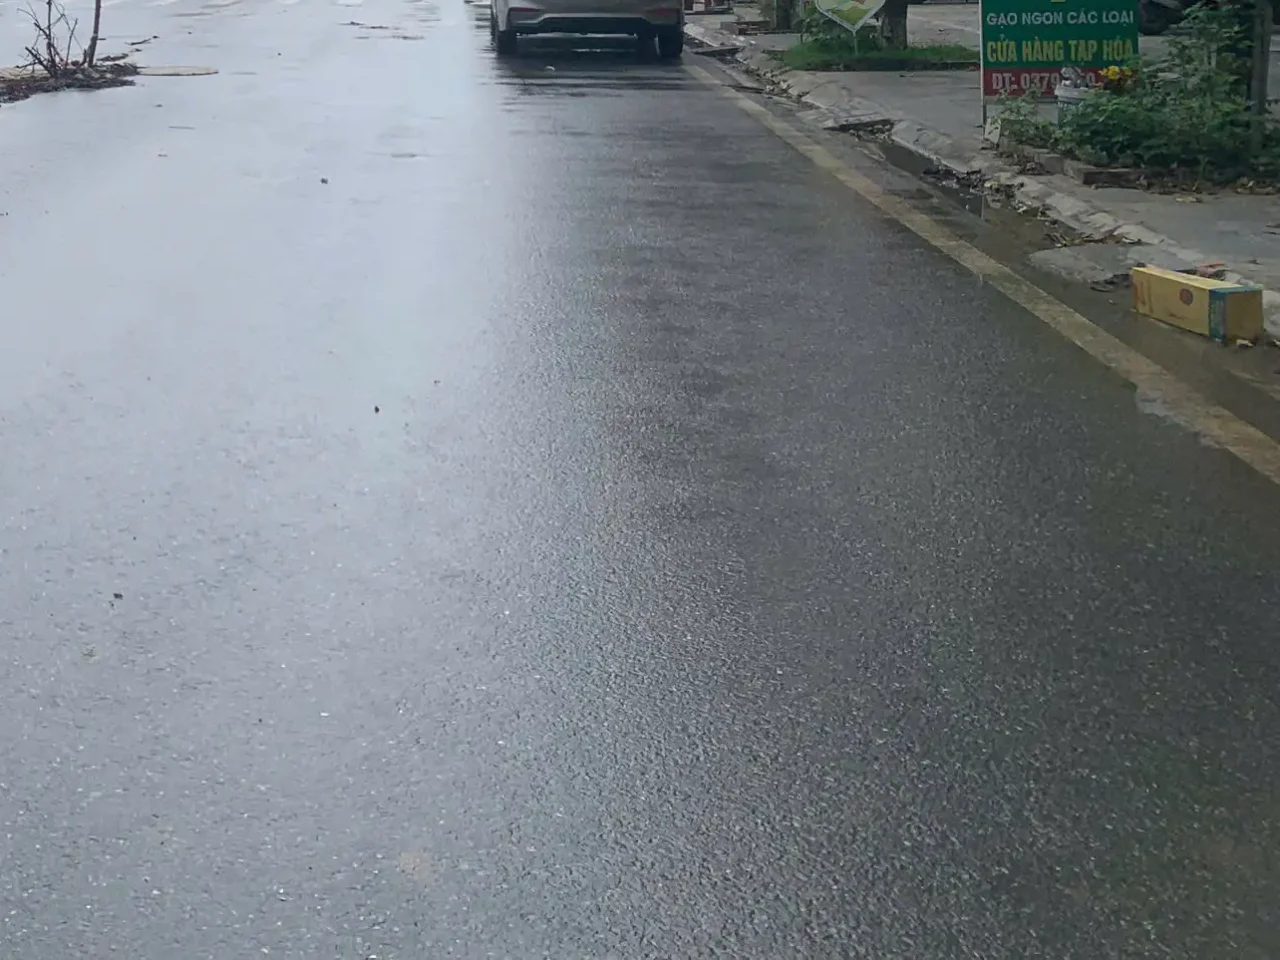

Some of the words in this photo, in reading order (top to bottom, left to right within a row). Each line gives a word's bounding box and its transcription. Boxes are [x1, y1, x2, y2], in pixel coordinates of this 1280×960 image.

[986, 12, 1018, 29] GẠO
[1021, 11, 1063, 25] NGON
[1066, 8, 1098, 24] CÁC
[1102, 10, 1134, 27] LOẠI
[987, 33, 1018, 62] CỬA
[1022, 36, 1064, 62] HÀNG
[1068, 40, 1098, 66] TẠP
